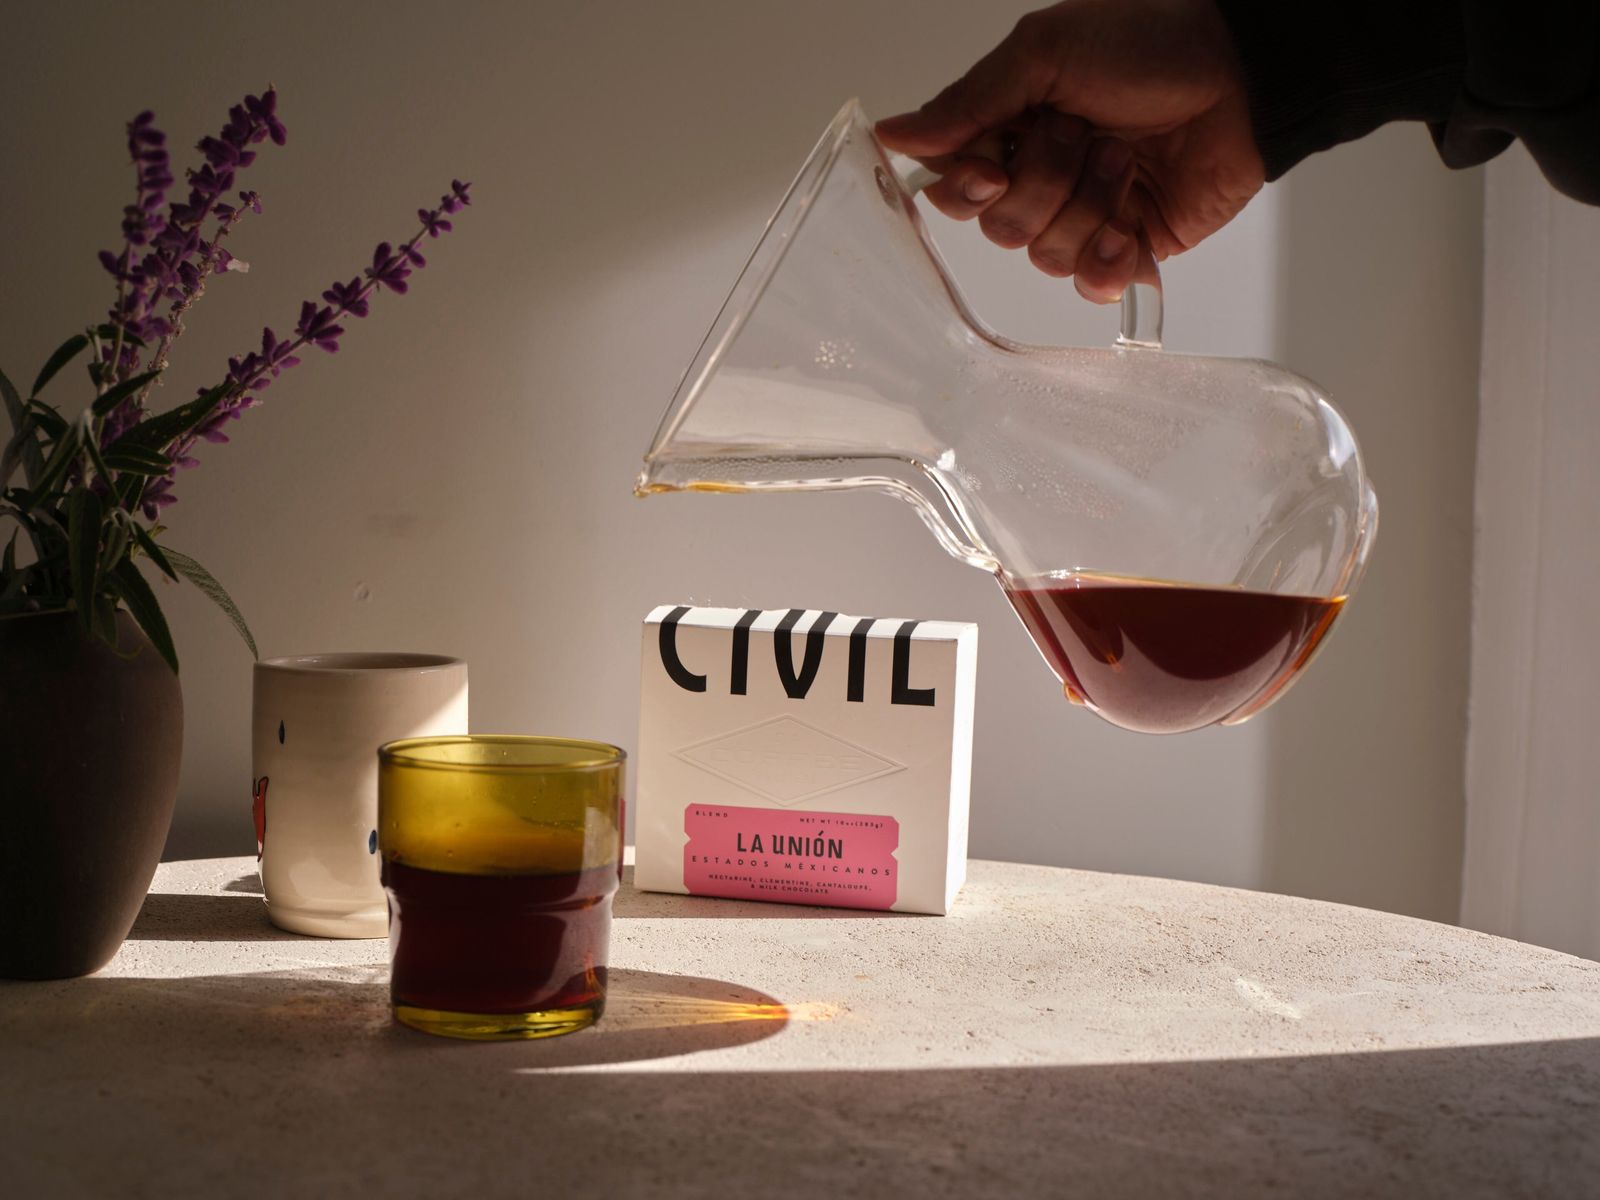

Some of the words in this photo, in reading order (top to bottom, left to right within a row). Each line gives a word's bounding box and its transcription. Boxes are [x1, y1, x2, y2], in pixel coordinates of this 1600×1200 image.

[659, 607, 936, 706] CIVIL
[737, 833, 764, 853] LA
[772, 830, 843, 859] UNIÓN
[692, 856, 769, 868] ESTADOS
